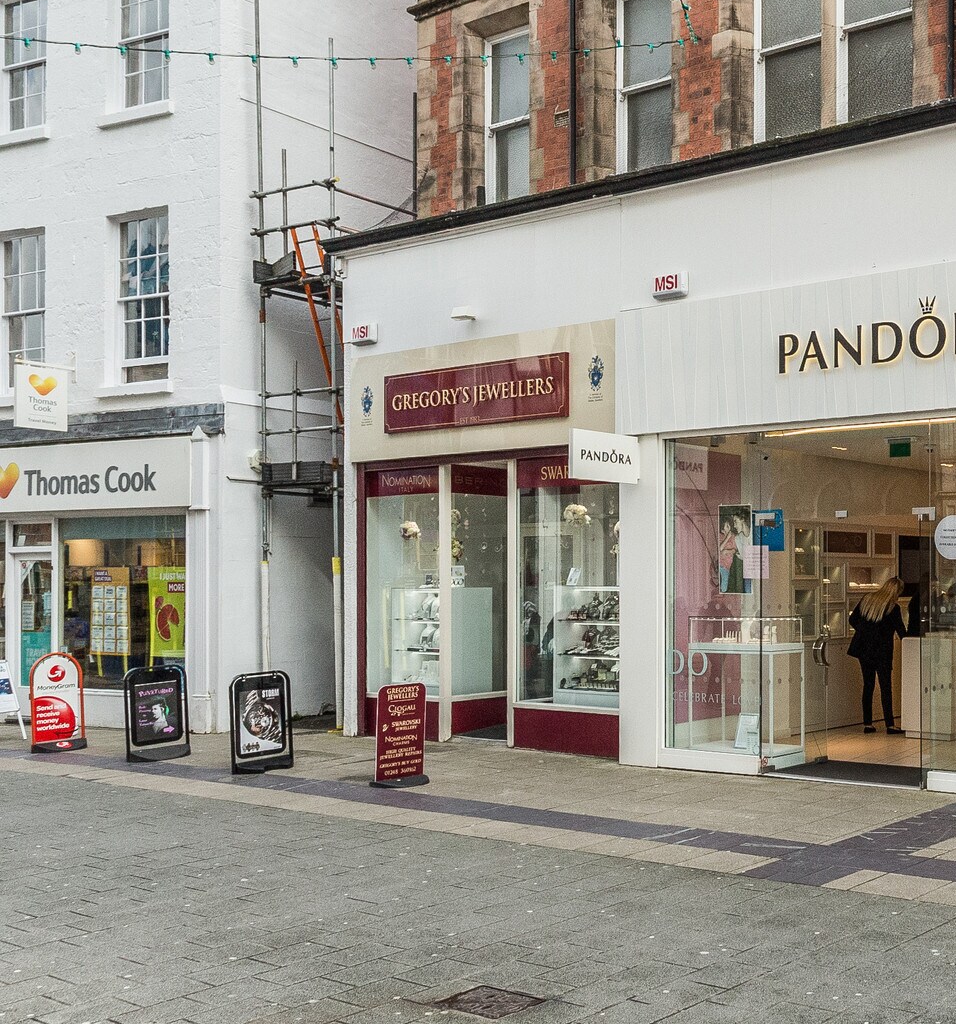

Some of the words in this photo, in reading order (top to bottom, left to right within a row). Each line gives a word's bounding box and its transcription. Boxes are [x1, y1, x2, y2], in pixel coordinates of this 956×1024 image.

[655, 274, 678, 292] MSI
[352, 325, 369, 339] MSI
[392, 386, 470, 411] GREGORY'S
[472, 376, 554, 407] JEWELLERS
[28, 396, 57, 406] Thomas
[33, 404, 52, 412] Cook
[580, 449, 632, 465] PANDORA
[24, 469, 100, 496] Thomas
[104, 463, 157, 493] Cook
[168, 583, 185, 592] MORE
[37, 683, 76, 691] MoneyGram
[386, 686, 419, 694] GREGORY'S
[388, 692, 418, 701] JEWELLERS
[36, 723, 70, 731] worldwide
